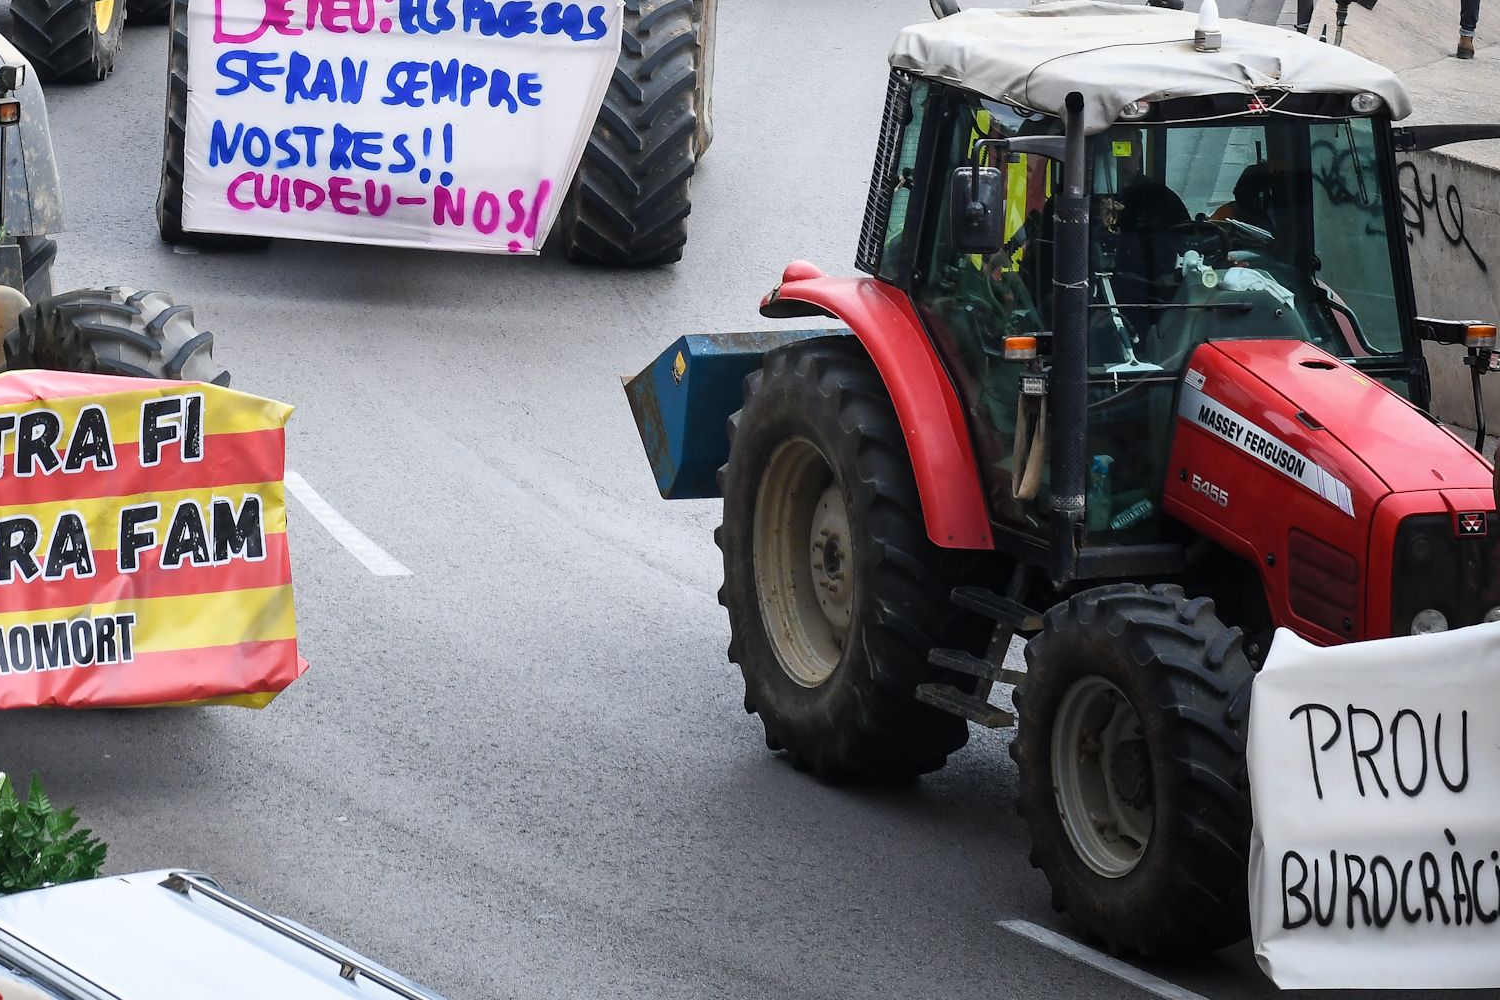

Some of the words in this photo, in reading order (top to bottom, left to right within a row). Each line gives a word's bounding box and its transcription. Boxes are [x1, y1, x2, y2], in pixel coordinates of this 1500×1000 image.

[215, 49, 368, 105] SERAN
[381, 57, 544, 114] SEMPRE
[226, 170, 552, 253] CUIDEU-NOS!
[140, 394, 205, 466] FI
[1198, 404, 1244, 443] MASSEY
[1244, 429, 1306, 479] FERGUSON
[1191, 473, 1229, 508] 5455
[118, 494, 267, 572] FAM
[1290, 703, 1468, 800] PROU
